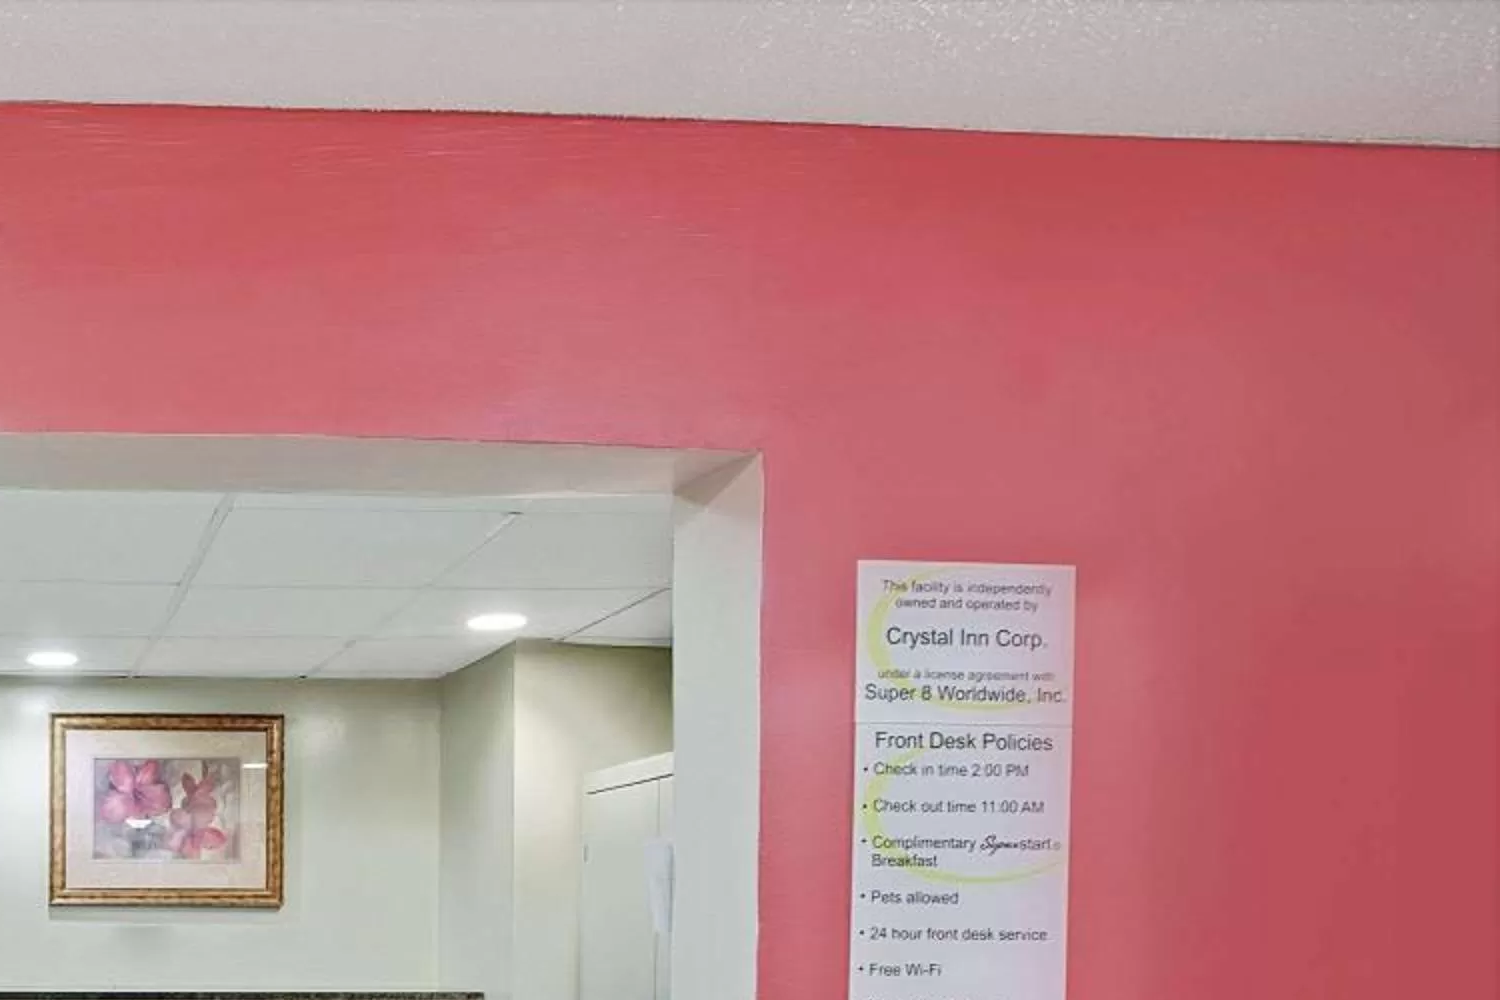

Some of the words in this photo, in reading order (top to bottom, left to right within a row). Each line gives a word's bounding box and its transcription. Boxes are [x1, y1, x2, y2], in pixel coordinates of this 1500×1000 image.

[883, 579, 908, 592] This
[911, 581, 949, 594] facility
[954, 582, 963, 593] is
[967, 583, 1052, 596] independently
[895, 599, 936, 609] owned
[940, 598, 962, 609] and
[965, 599, 1020, 611] operated
[1024, 599, 1038, 612] by
[886, 627, 953, 649] Crystal
[961, 629, 989, 646] Inn
[996, 630, 1048, 651] Corp.
[878, 668, 910, 679] under
[913, 670, 920, 679] a
[924, 669, 964, 680] license
[968, 672, 1029, 682] agreement
[865, 684, 916, 702] Super
[921, 685, 932, 700] 8
[937, 685, 1031, 705] Worldwide,
[1038, 687, 1067, 704] Inc.
[875, 731, 924, 749] Front
[929, 732, 976, 749] Desk
[983, 733, 1053, 751] Policies
[873, 762, 917, 776] Check
[922, 764, 935, 776] in
[938, 764, 968, 776] time
[1005, 764, 1029, 777] PM
[873, 799, 916, 813] Check
[921, 801, 943, 813] out
[947, 801, 976, 813] time
[1021, 801, 1044, 813] AM
[871, 835, 976, 851] Complimentary
[871, 854, 937, 867] Breakfast
[871, 891, 902, 904] Pets
[906, 892, 959, 905] allowed
[870, 927, 887, 940] 24
[891, 928, 921, 940] hour
[927, 928, 958, 941] front
[962, 928, 994, 941] desk
[1000, 929, 1047, 941] service
[869, 964, 901, 976] Free
[905, 964, 942, 976] Wi-Fi
